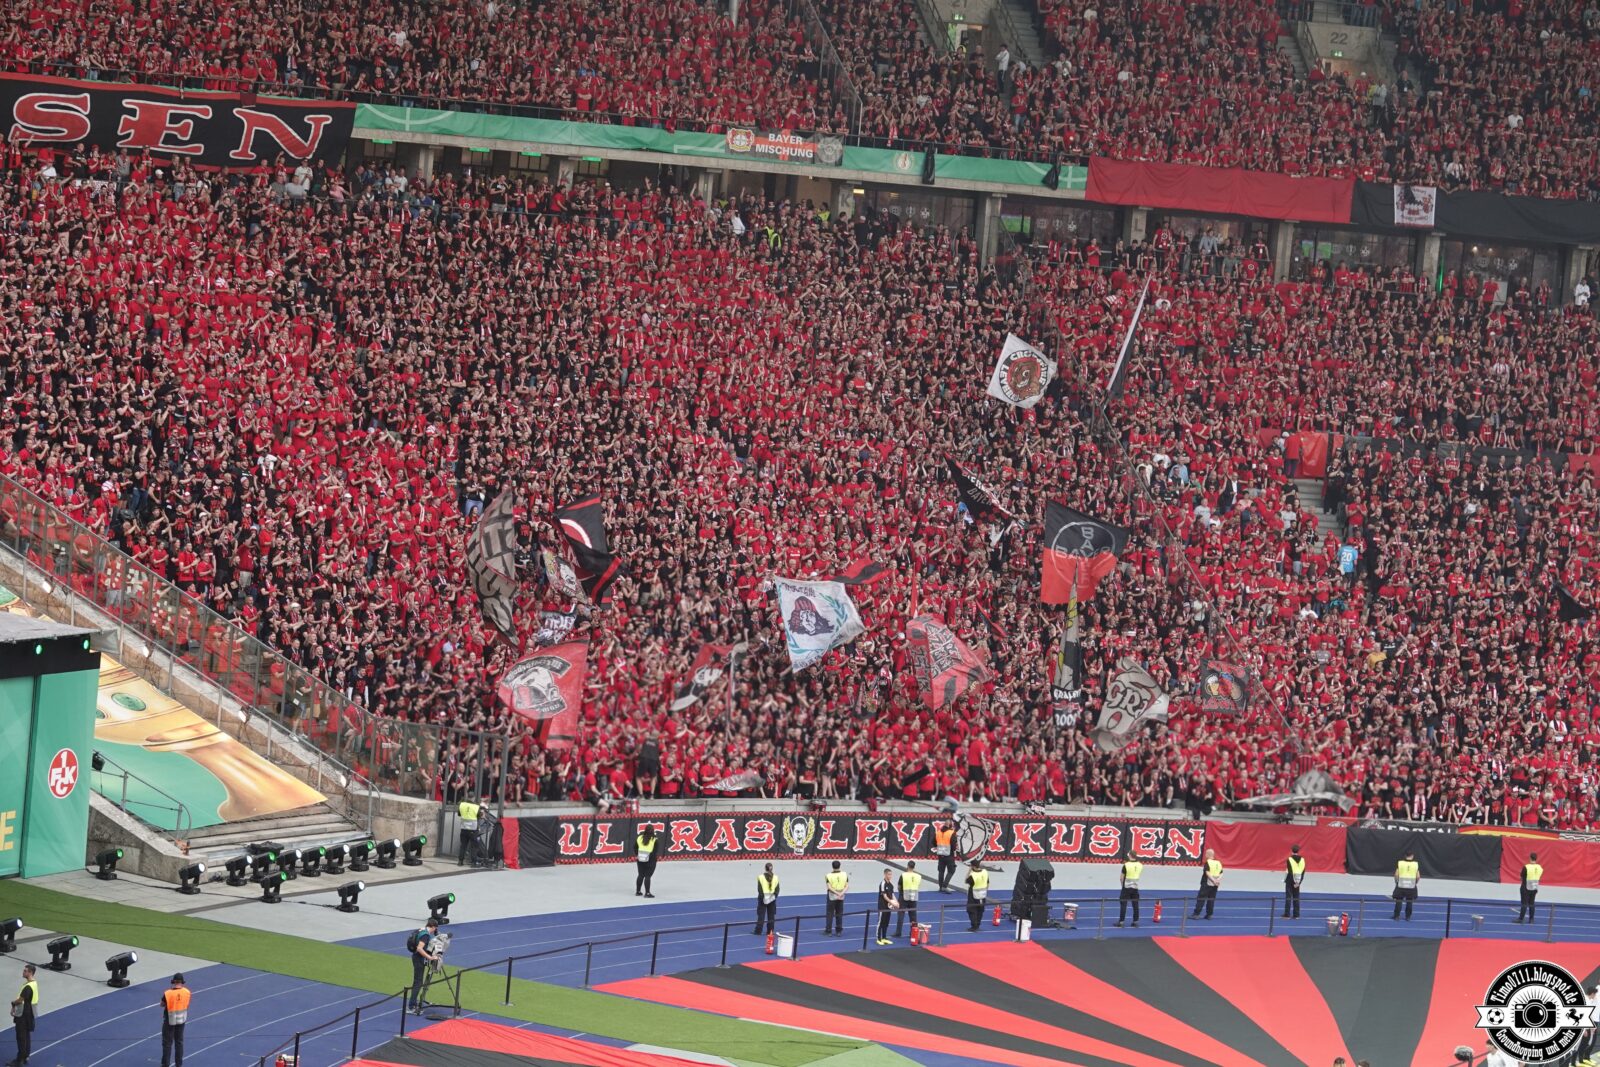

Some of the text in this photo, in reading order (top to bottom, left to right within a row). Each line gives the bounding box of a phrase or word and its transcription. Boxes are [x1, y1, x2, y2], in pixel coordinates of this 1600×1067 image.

[1330, 32, 1348, 45] 22
[8, 92, 333, 160] SEN
[768, 132, 803, 145] BAYER
[755, 144, 814, 159] MISCHUNG
[1341, 551, 1353, 562] 20
[816, 820, 1205, 861] LEVKUSEN
